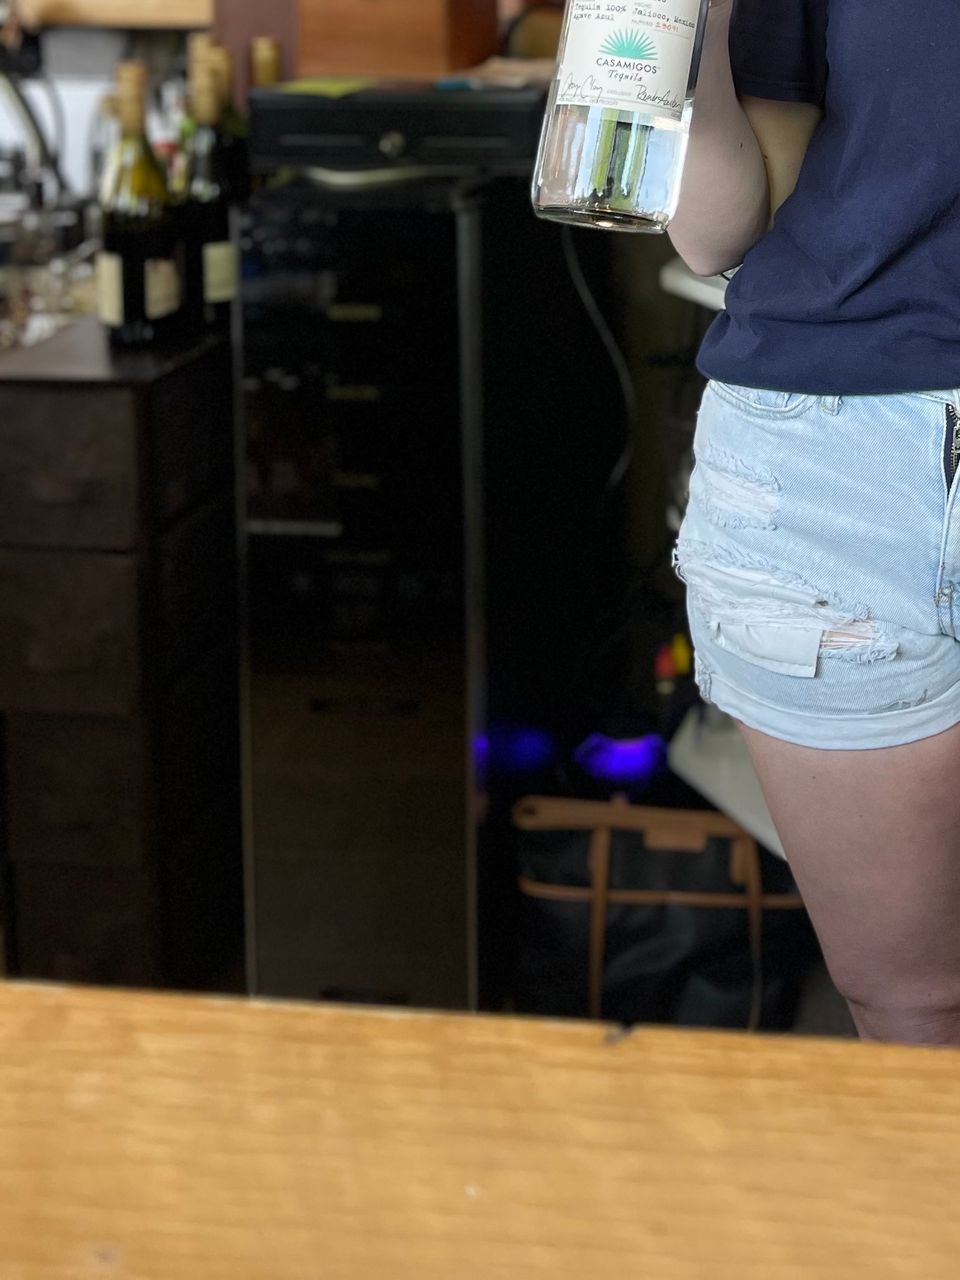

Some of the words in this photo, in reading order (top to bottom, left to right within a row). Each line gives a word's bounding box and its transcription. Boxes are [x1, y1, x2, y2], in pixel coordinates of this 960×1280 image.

[606, 4, 627, 13] 100%
[632, 7, 670, 22] Jalisco,
[596, 57, 658, 74] CASAMIGOS
[608, 69, 643, 82] Tequila
